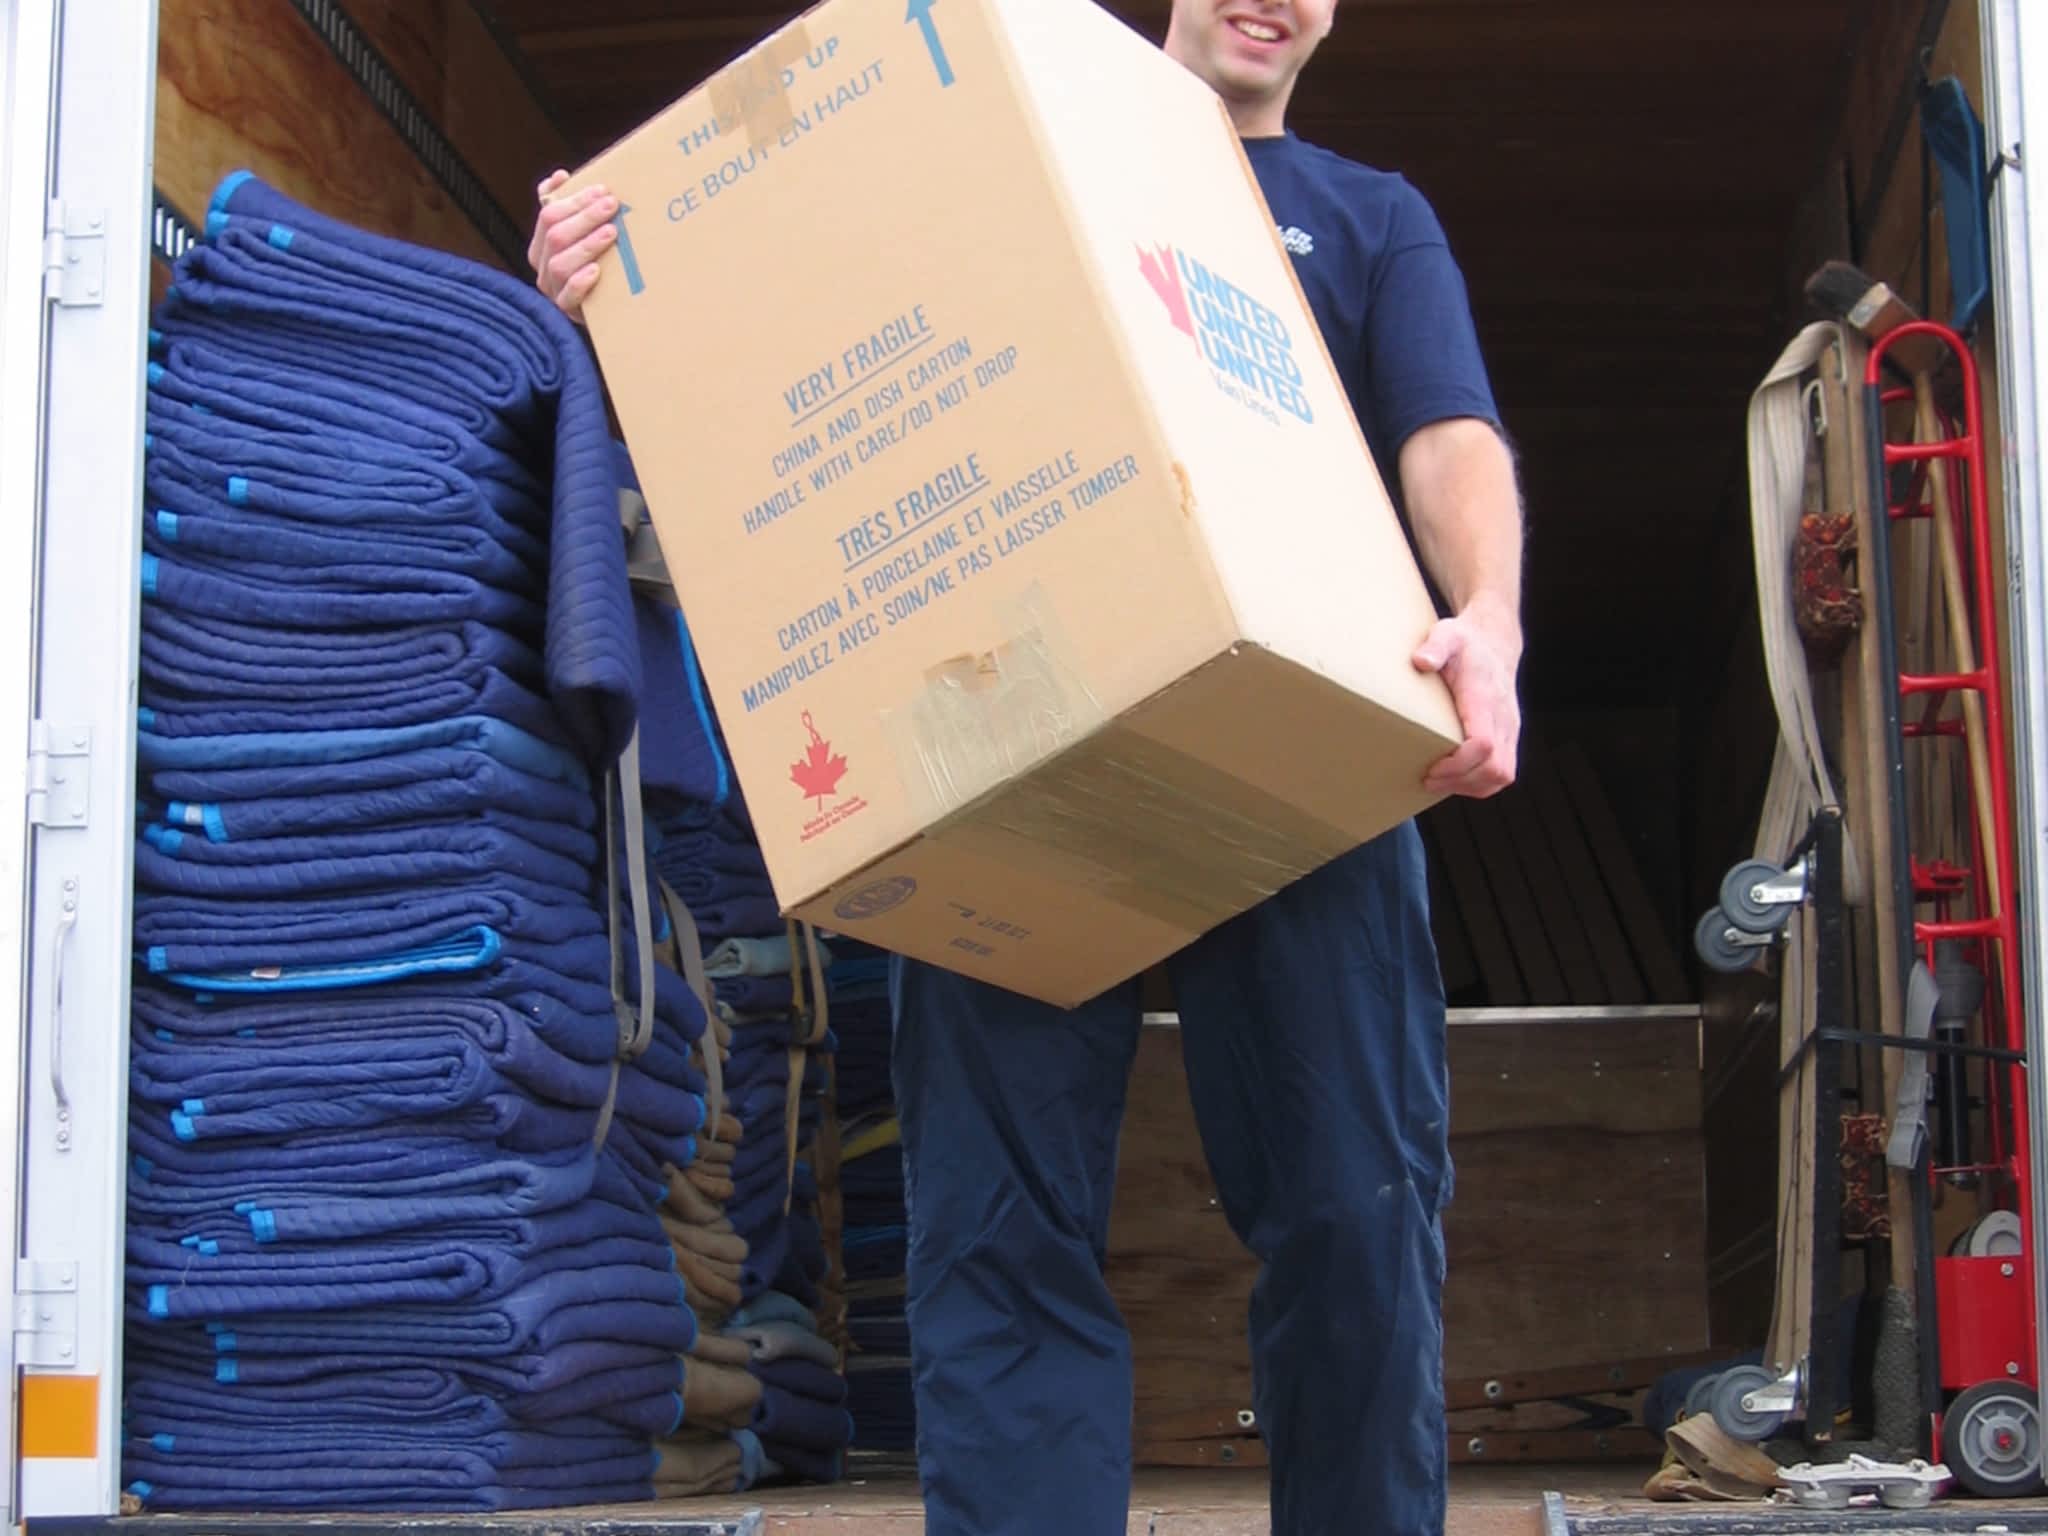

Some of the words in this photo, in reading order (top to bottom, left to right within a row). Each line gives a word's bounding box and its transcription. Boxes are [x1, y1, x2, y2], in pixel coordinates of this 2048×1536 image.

[805, 36, 839, 69] UP
[665, 189, 702, 224] CE
[814, 58, 886, 124] HAUT
[1176, 247, 1292, 351] UNITED
[1187, 288, 1302, 387] UNITED
[772, 434, 823, 479] CHINA
[827, 408, 861, 445] AND
[864, 381, 904, 421] DISH
[907, 336, 972, 392] CARTON
[783, 363, 837, 417] VERY
[841, 303, 932, 380] FRAGILE
[1199, 326, 1314, 424] UNITED
[742, 479, 807, 535] HANDLE
[808, 451, 855, 492] WITH
[855, 399, 933, 464] CARE/DO
[936, 378, 970, 414] NOT
[974, 345, 1018, 388] DROP
[777, 597, 843, 652] CARTON
[847, 583, 861, 612] À
[861, 523, 962, 599] PORCELAINE
[963, 506, 988, 537] ET
[990, 450, 1081, 519] VAISSELLE
[836, 511, 893, 563] TRÈS
[895, 452, 987, 528] FRAGILE
[741, 641, 834, 713] MANIPULEZ
[837, 613, 881, 655] AVEC
[883, 569, 956, 627] SOIN/NE
[957, 543, 994, 582] PAS
[994, 500, 1067, 557] LAISSER
[1068, 454, 1140, 512] TOMBER
